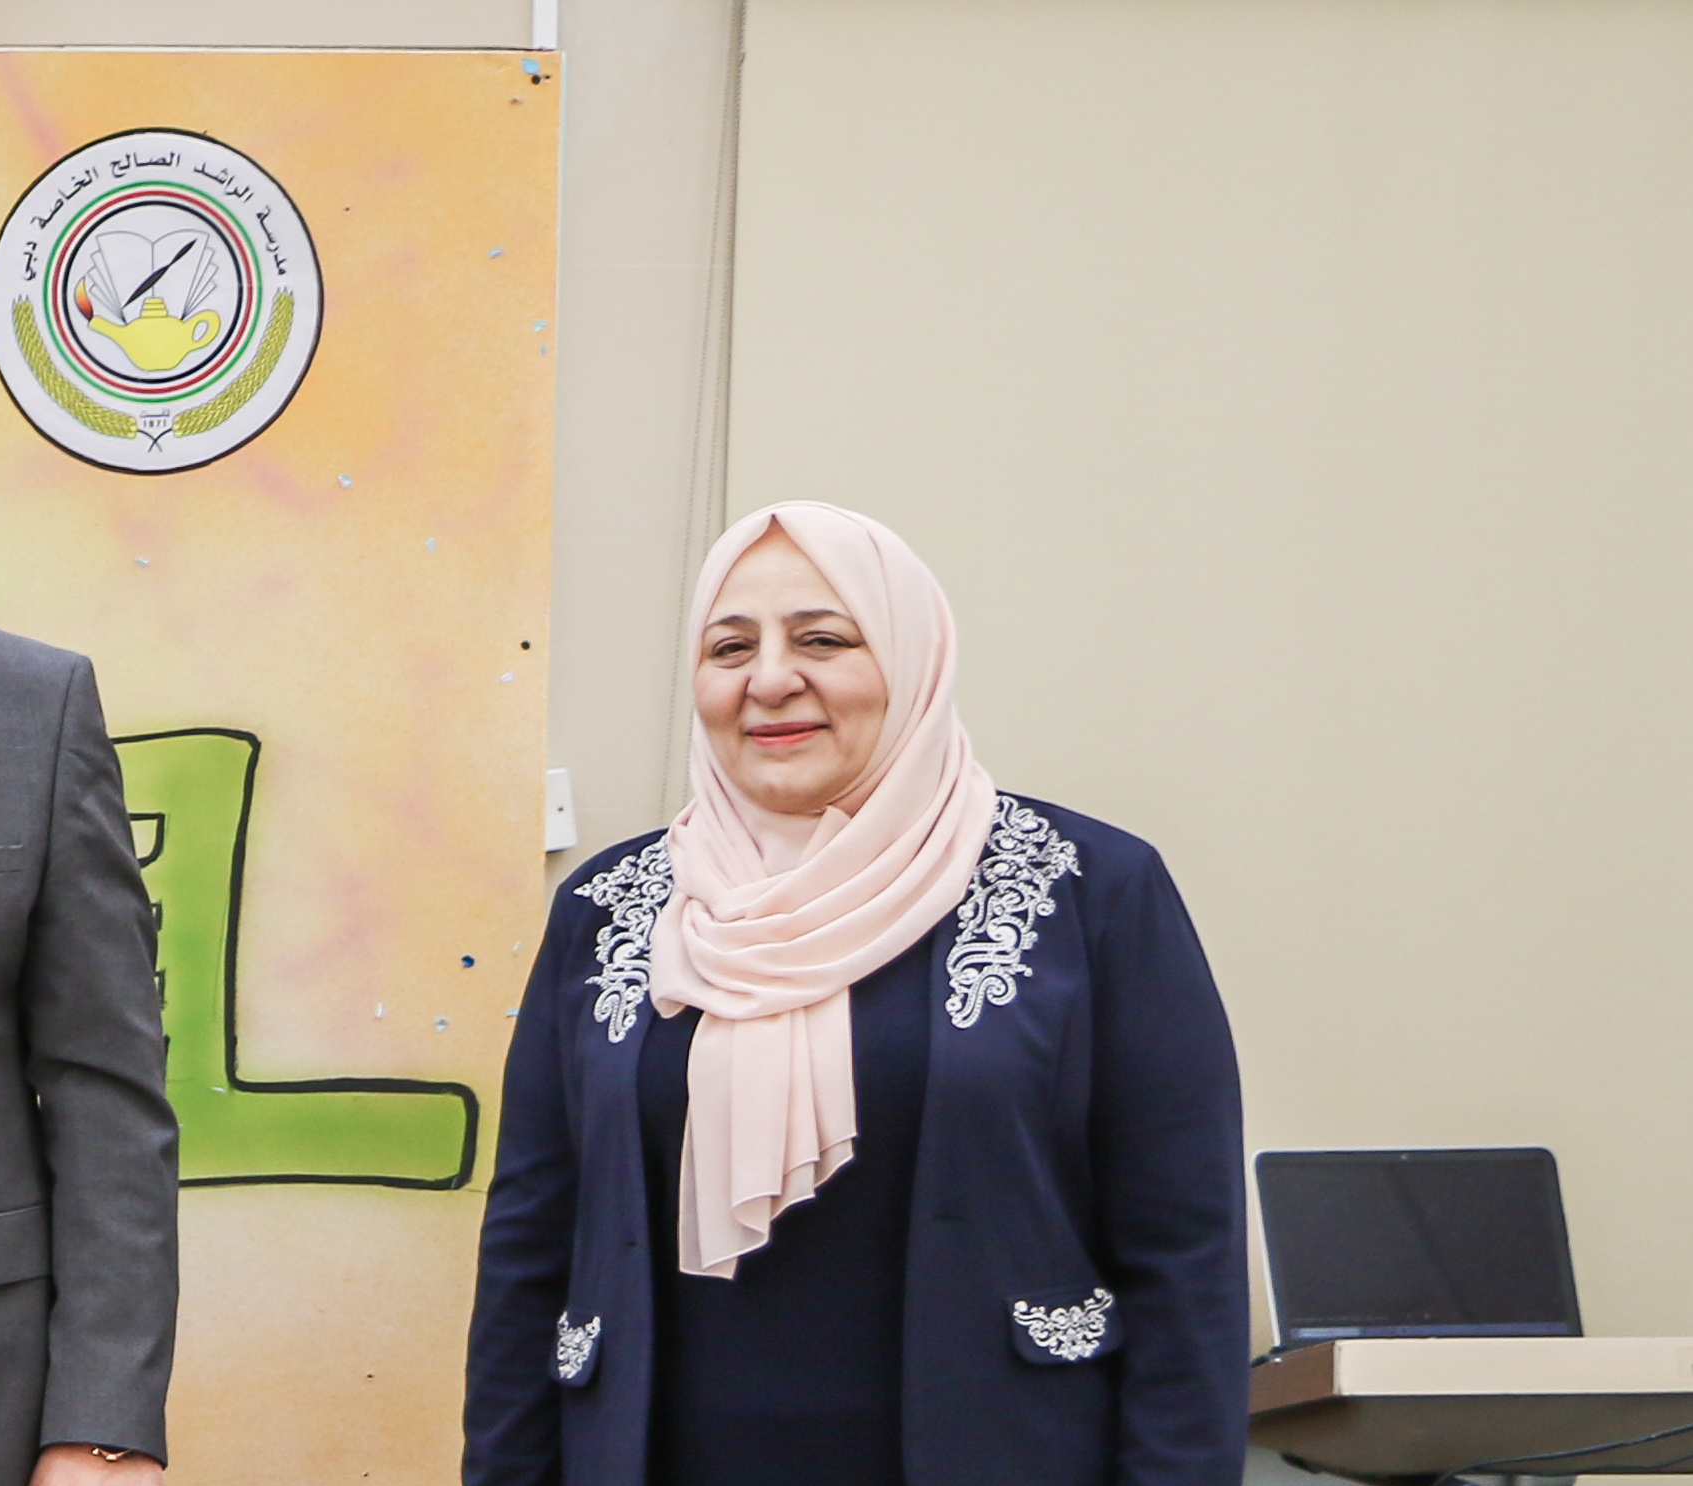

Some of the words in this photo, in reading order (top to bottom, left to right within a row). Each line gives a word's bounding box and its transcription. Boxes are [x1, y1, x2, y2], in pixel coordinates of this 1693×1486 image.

[109, 151, 181, 179] الصالح
[193, 160, 256, 204] الراشد
[30, 166, 99, 231] الخاصة
[21, 240, 39, 282] دبي
[256, 204, 288, 276] مدرسة
